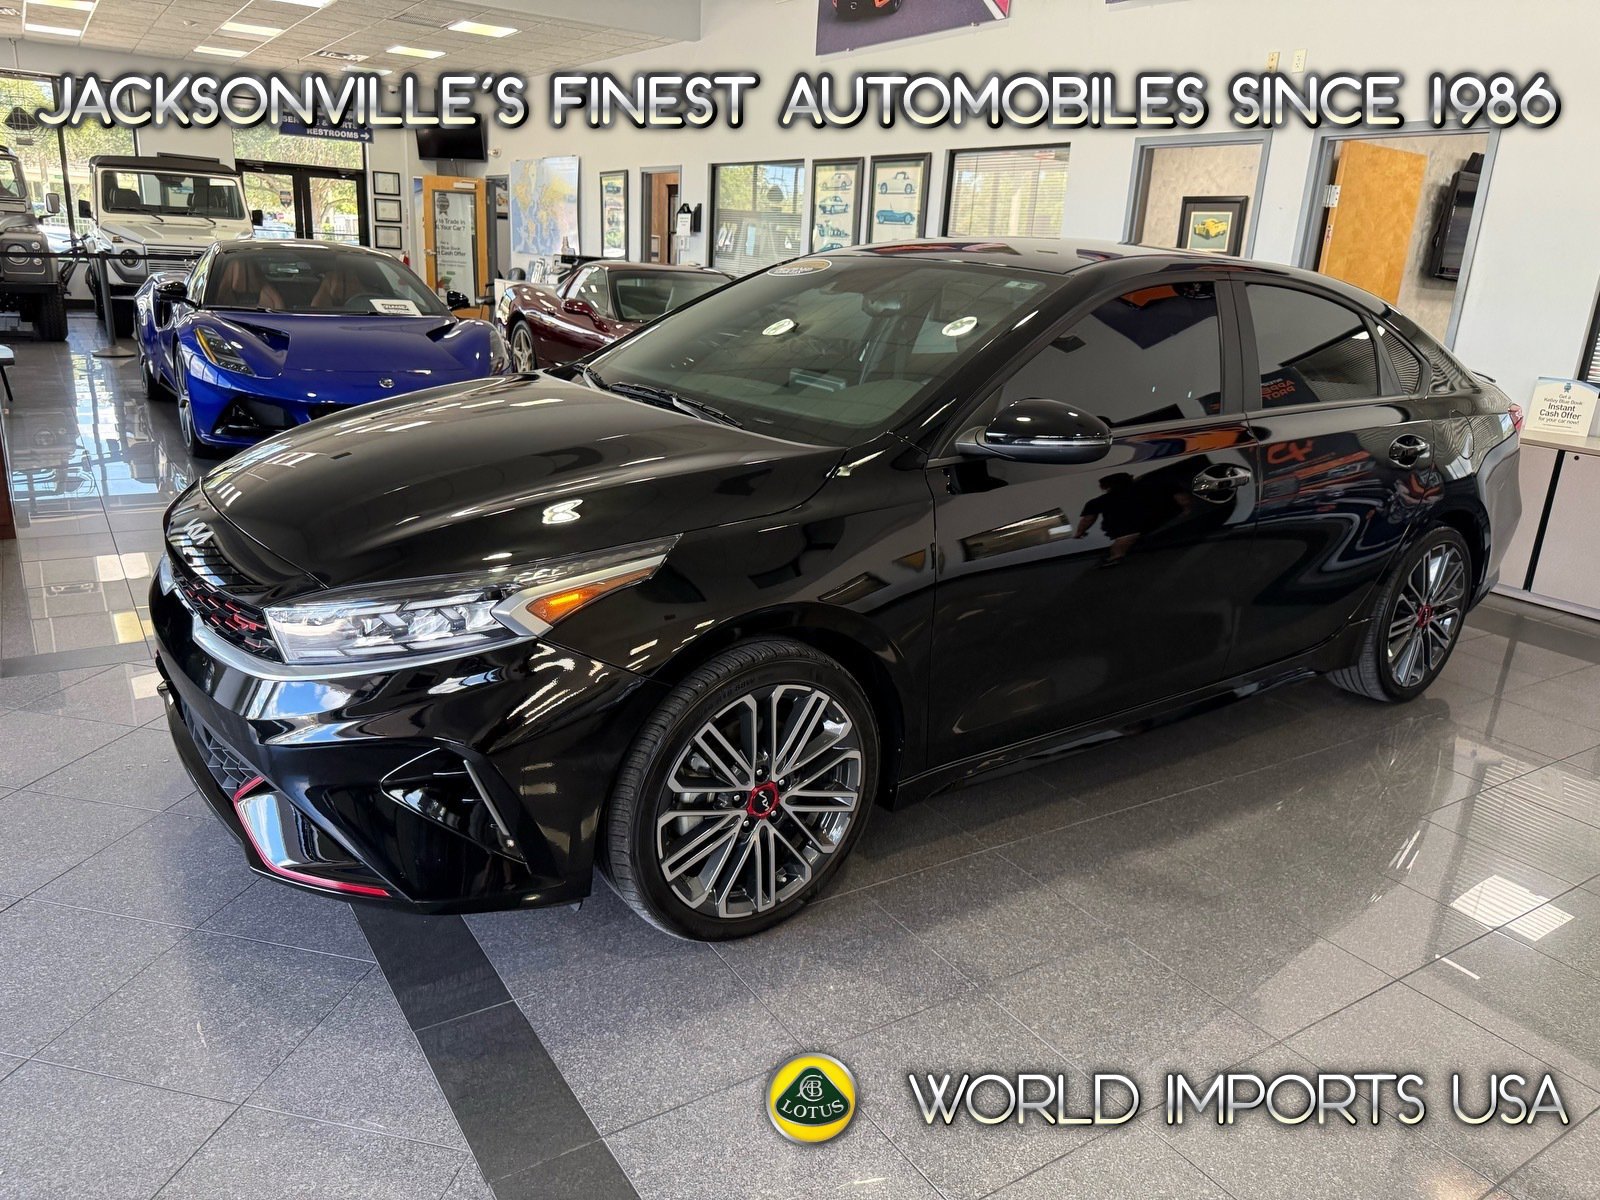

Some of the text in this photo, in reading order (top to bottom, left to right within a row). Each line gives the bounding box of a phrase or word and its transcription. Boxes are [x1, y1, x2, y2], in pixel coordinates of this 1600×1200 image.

[306, 128, 359, 138] RESTROOMS
[1548, 403, 1576, 412] Instant
[1540, 409, 1582, 420] Cash Offer
